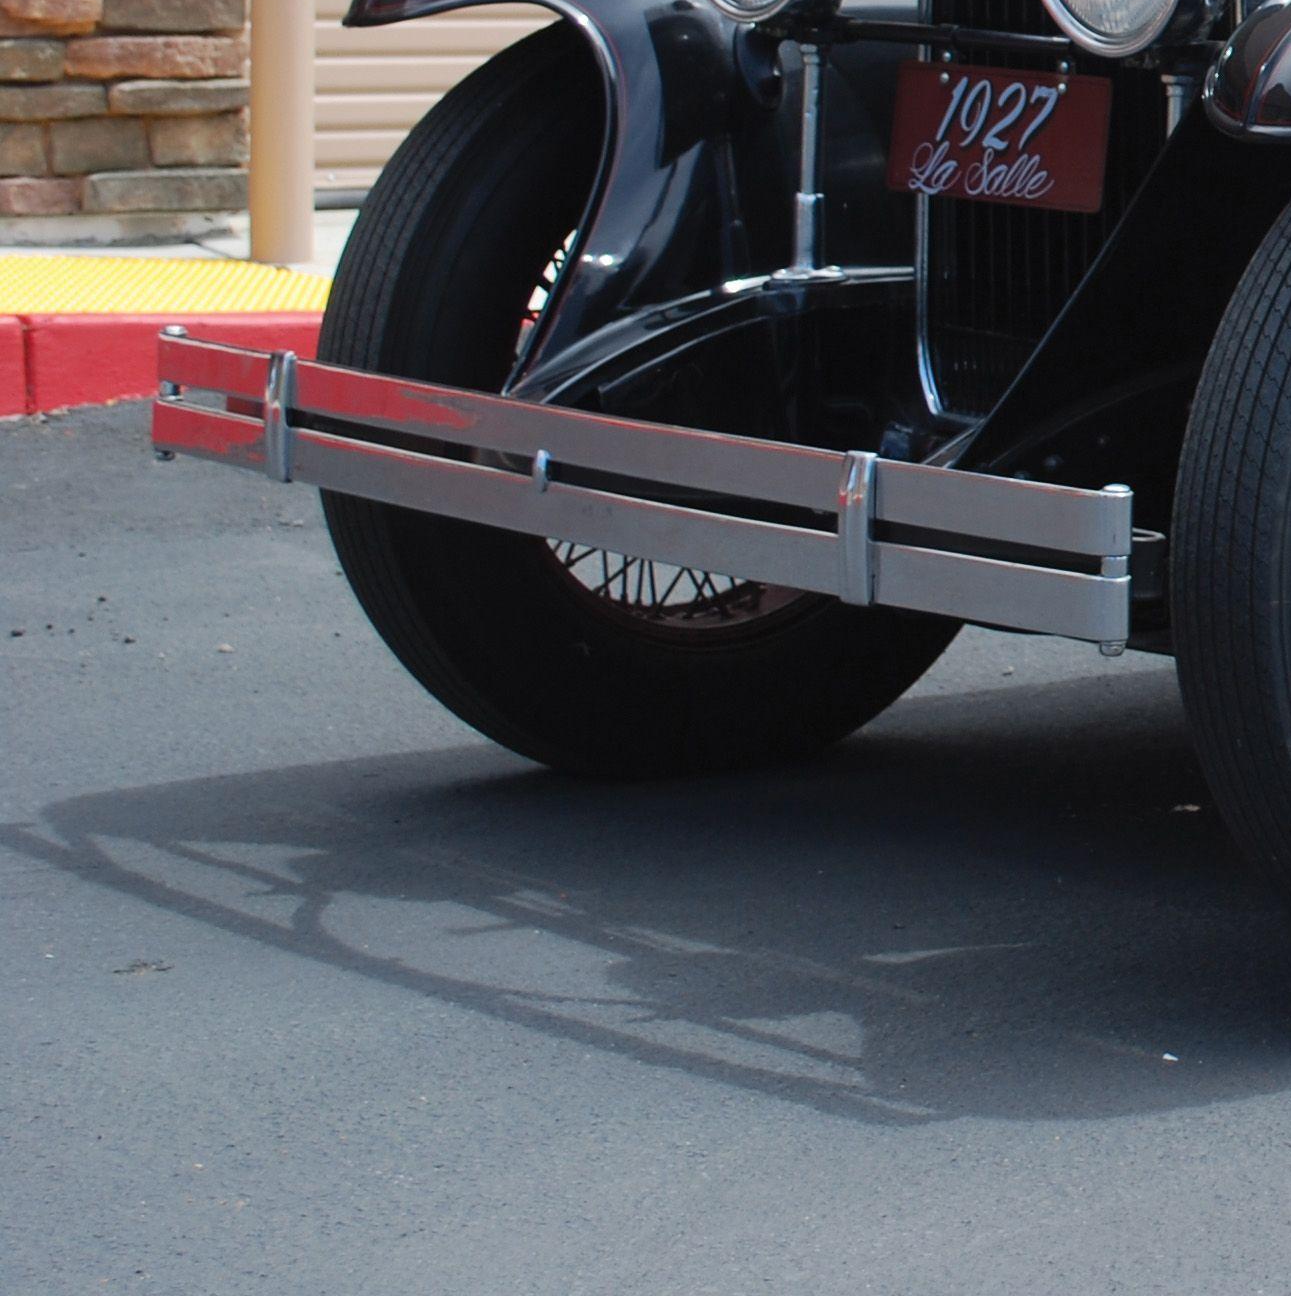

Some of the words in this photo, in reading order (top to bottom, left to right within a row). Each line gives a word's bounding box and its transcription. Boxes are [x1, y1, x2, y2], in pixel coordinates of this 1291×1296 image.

[936, 76, 1058, 150] 1927
[908, 140, 960, 195] La
[964, 148, 1055, 199] Salle
